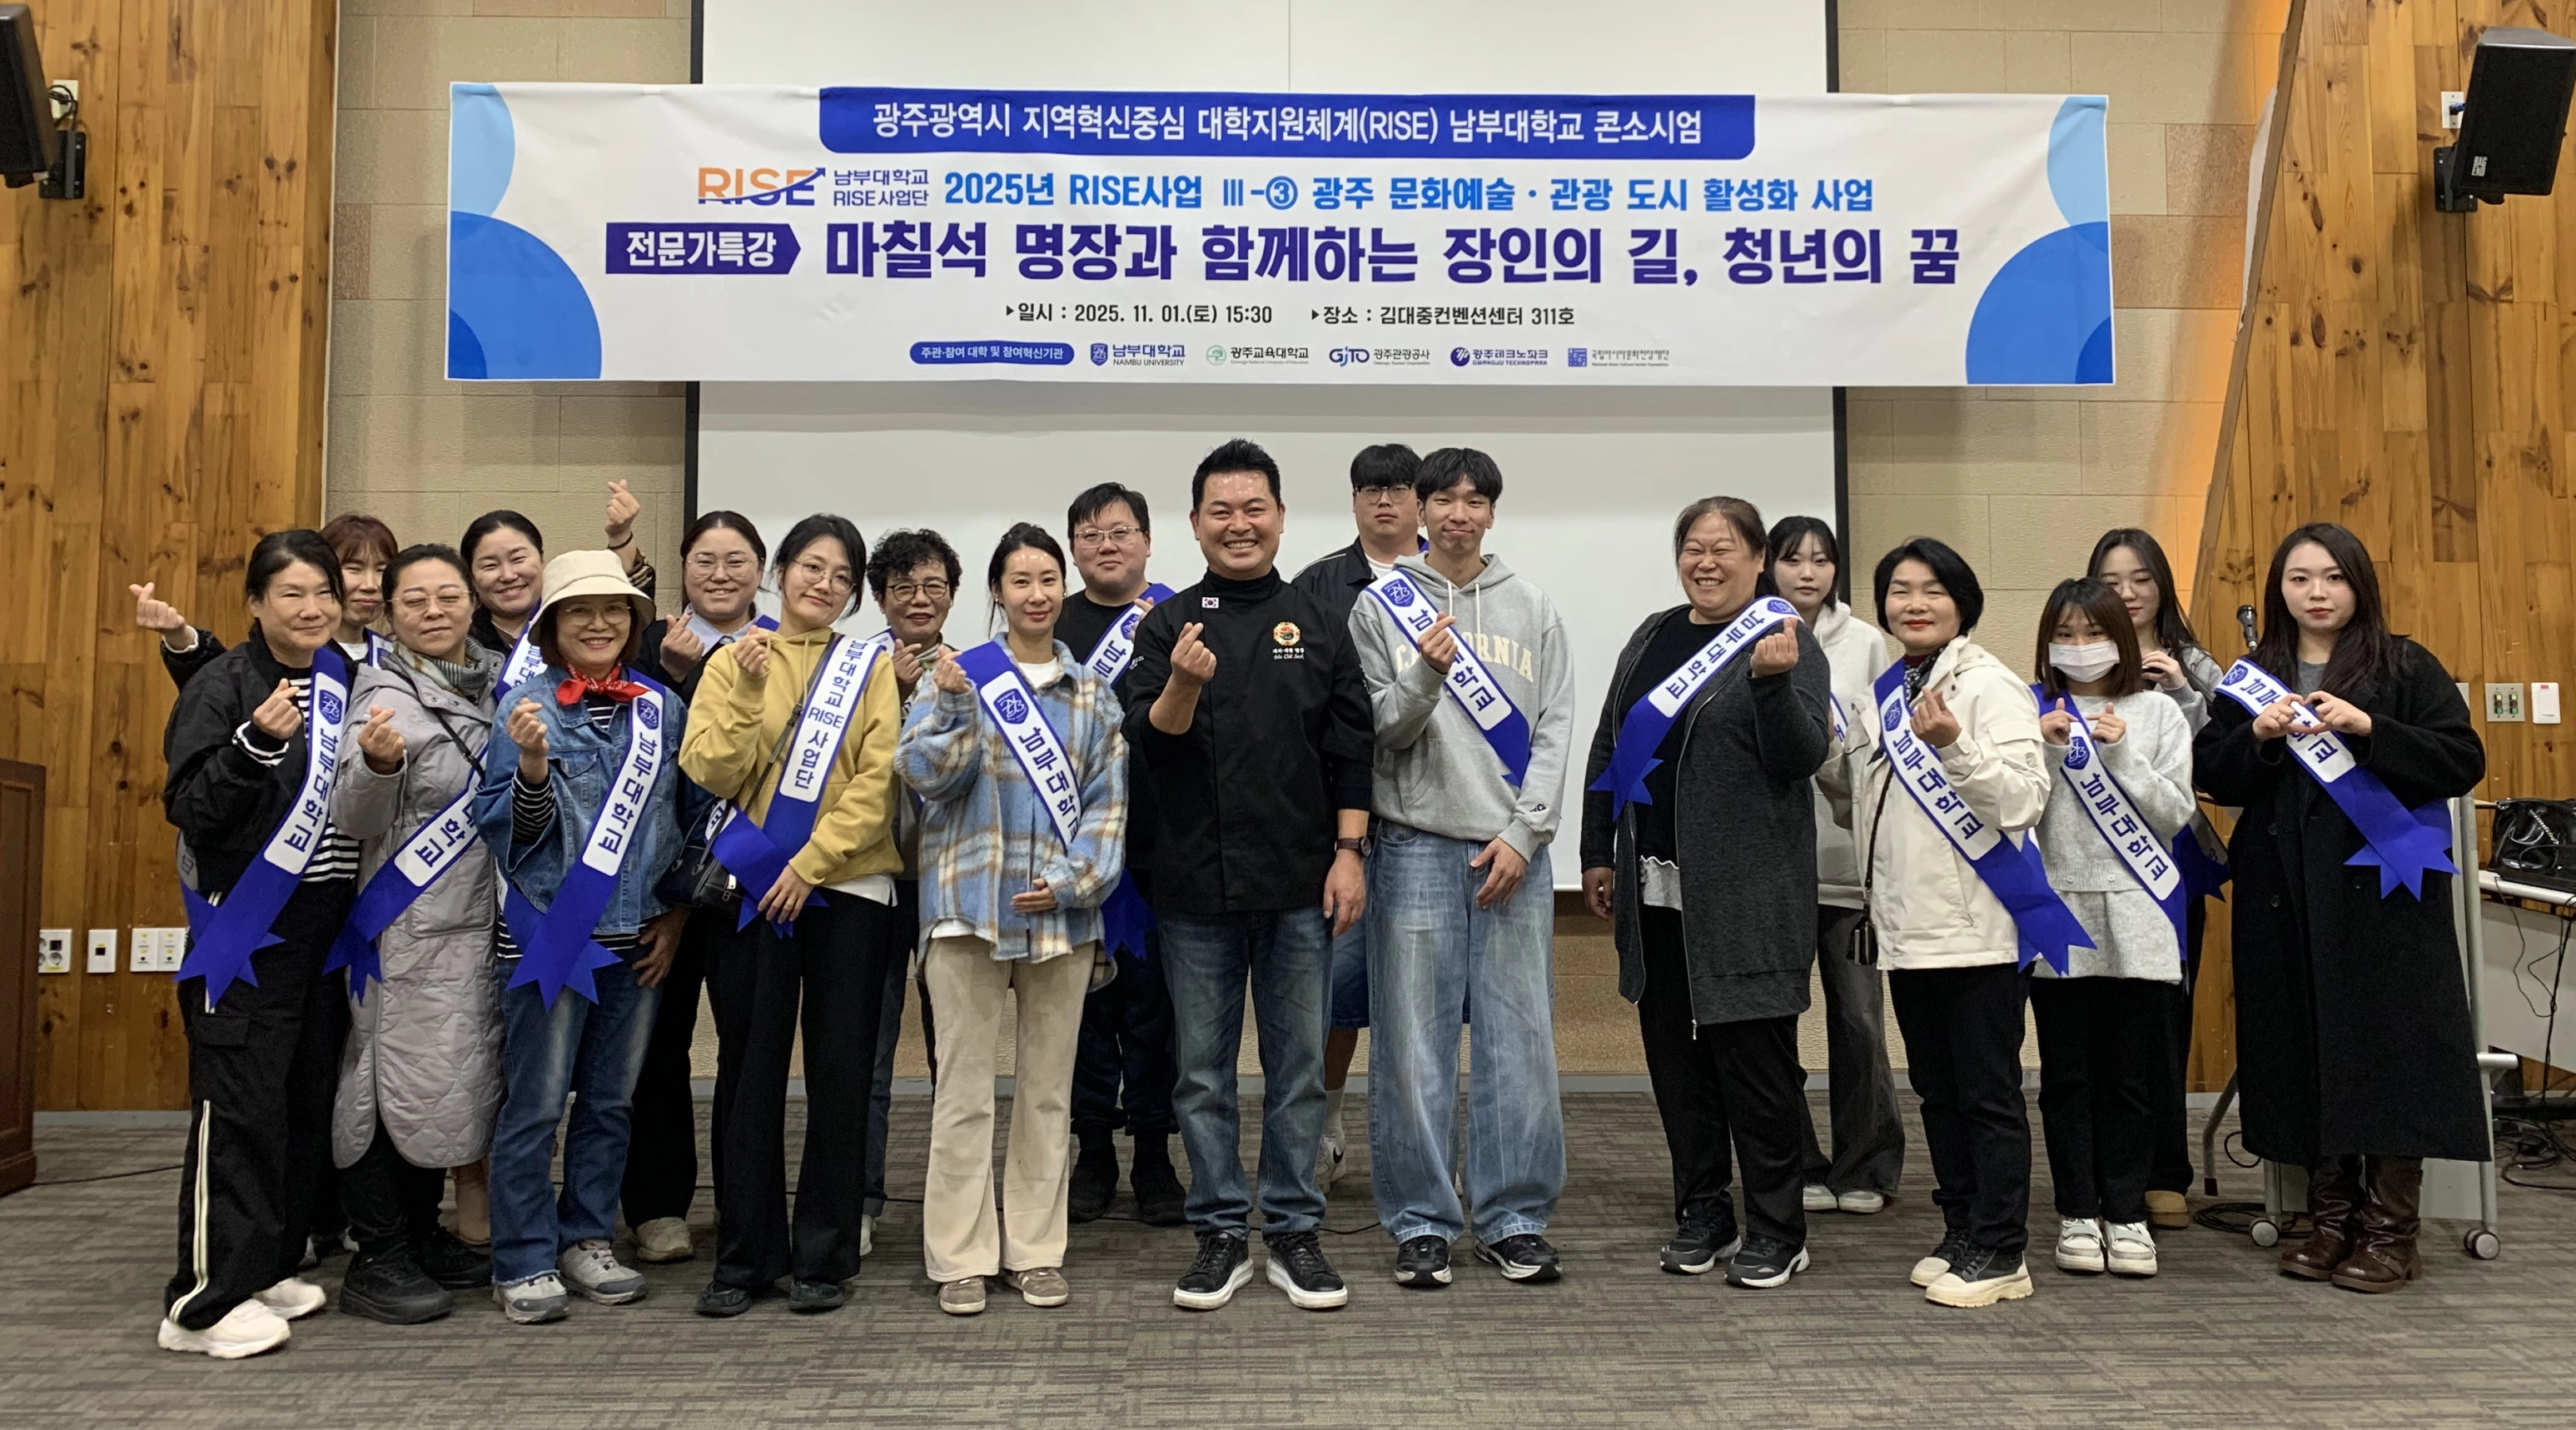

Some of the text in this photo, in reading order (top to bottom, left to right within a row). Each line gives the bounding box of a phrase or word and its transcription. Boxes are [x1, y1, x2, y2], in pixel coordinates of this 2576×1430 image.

[873, 102, 1701, 144] 광주광역시 지역혁신중심 대학지원체계(RISE) 남부대학교 콘소시엄
[698, 167, 817, 207] RISE
[834, 169, 928, 186] 남부대학교
[945, 172, 1053, 206] 2025년
[1070, 174, 1201, 208] RISE사업
[1313, 177, 1374, 210] 광주
[1390, 177, 1514, 211] 문화예술
[1550, 178, 1613, 211] 관광
[1628, 179, 1687, 211] 도시
[1704, 178, 1798, 212] 활성화
[1812, 179, 1872, 212] 사업
[833, 190, 928, 206] RISE사업단
[627, 232, 776, 267] 전문가특강
[827, 220, 1959, 286] 마칠석 명장과 함께하는 장인의 길, 청년의 꿈
[1018, 303, 1052, 321] 일시
[1076, 305, 1124, 321] 2025.
[1134, 305, 1152, 321] 11.
[1162, 305, 1216, 323] 01.(토)
[1226, 306, 1271, 323] 15:30
[1324, 306, 1358, 324] 장소
[1380, 306, 1522, 325] 김대중컨벤션센터
[1532, 307, 1574, 325] 311호
[967, 346, 987, 357] 대학
[991, 346, 999, 356] 및
[1003, 346, 1063, 359] 참여혁신기관
[1113, 344, 1185, 358] 남부대학교
[1231, 347, 1308, 358] 광주교육대학교
[1374, 349, 1430, 360] 광주관광공사
[1473, 350, 1549, 359] 광주테크노파크
[1408, 609, 1496, 711] 남학교
[1666, 610, 1765, 700] 남부대학교
[794, 640, 869, 790] 남부대학교 RISE 사업단
[284, 728, 338, 853] 남부대학교
[598, 732, 657, 855] 남부대학교
[1892, 729, 1984, 840] 남부대학교
[2080, 773, 2169, 881] 남부대학교
